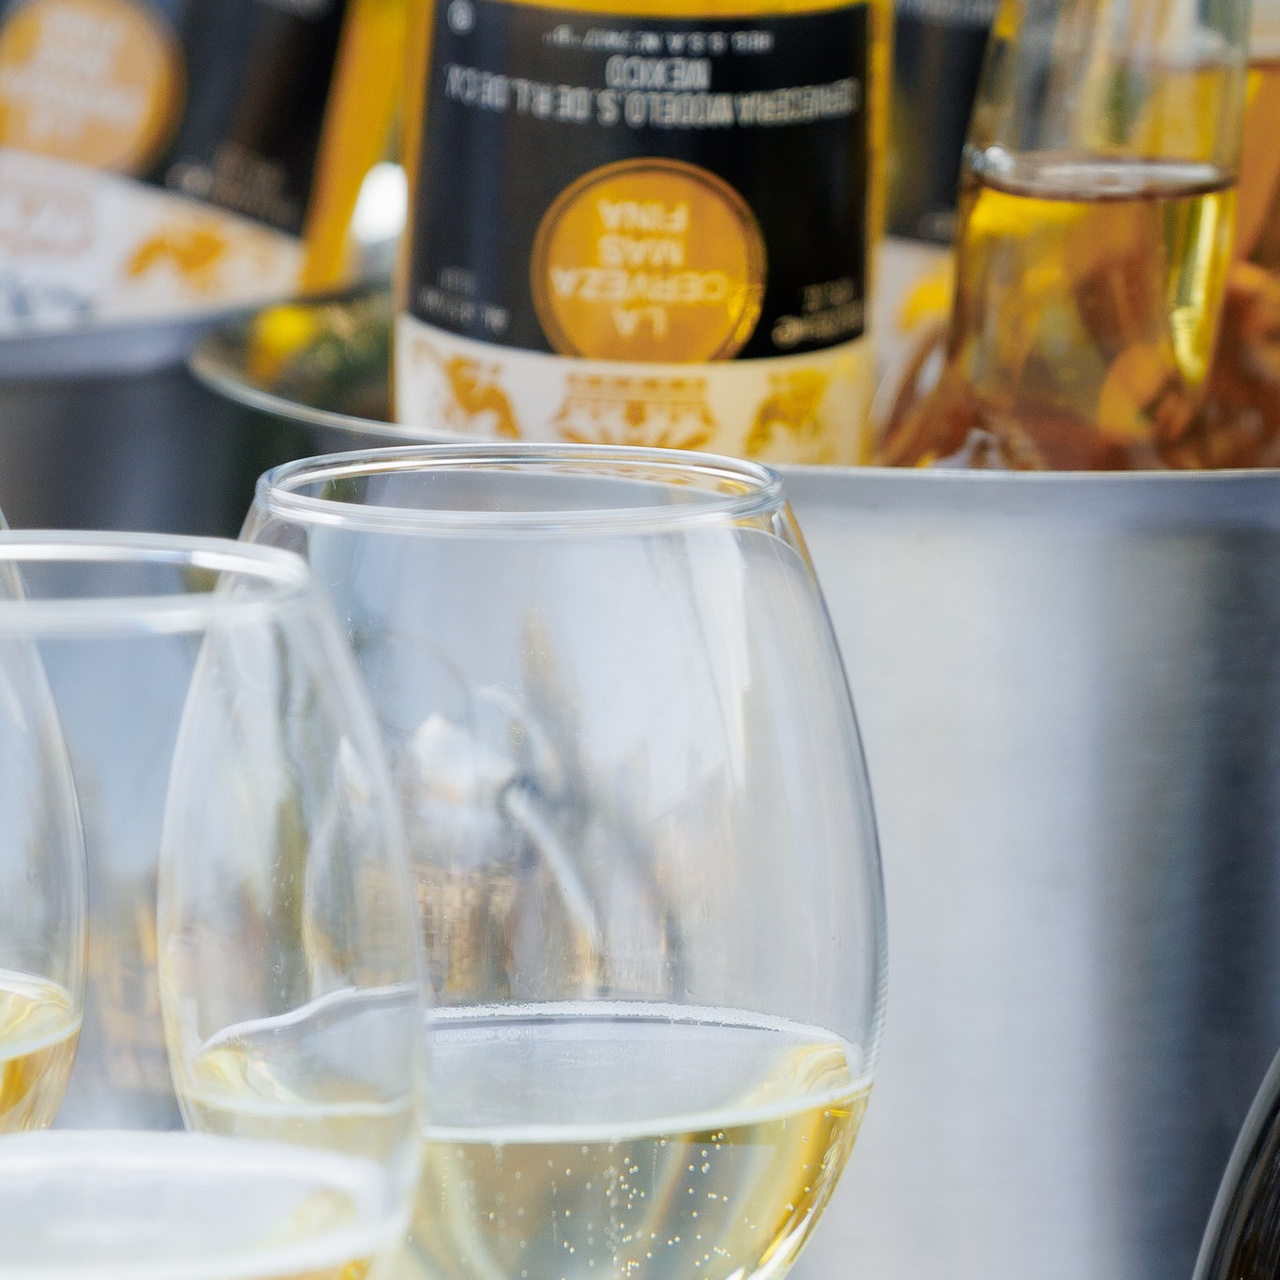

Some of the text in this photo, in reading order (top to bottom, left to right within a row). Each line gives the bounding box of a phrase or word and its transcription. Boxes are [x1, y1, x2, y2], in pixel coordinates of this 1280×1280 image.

[596, 198, 690, 233] FINA
[599, 236, 685, 267] MAS
[550, 267, 730, 301] CERVEZA
[612, 307, 669, 340] LA
